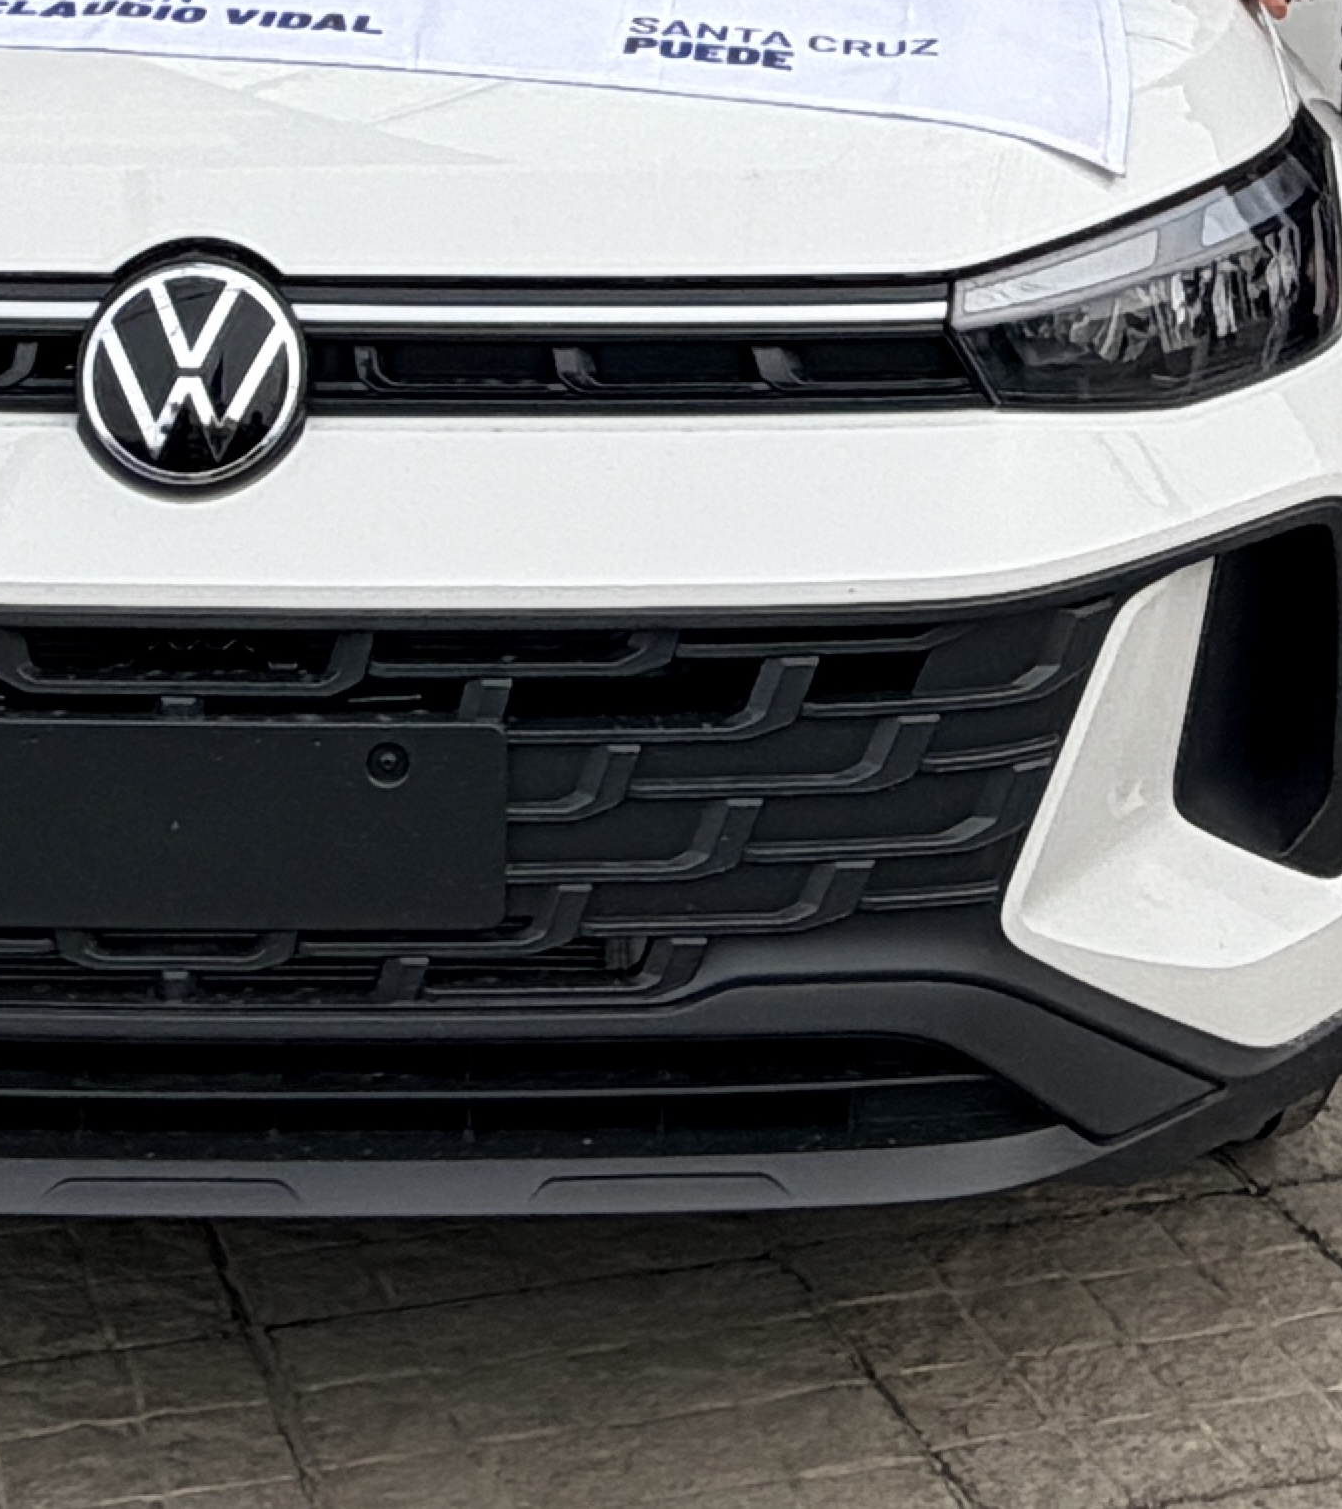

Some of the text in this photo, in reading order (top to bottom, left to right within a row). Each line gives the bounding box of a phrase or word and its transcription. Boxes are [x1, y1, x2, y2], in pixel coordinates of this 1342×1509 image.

[225, 7, 385, 36] VIDAL
[629, 17, 939, 57] SANTA CRUZ
[623, 37, 794, 71] PUEDE
